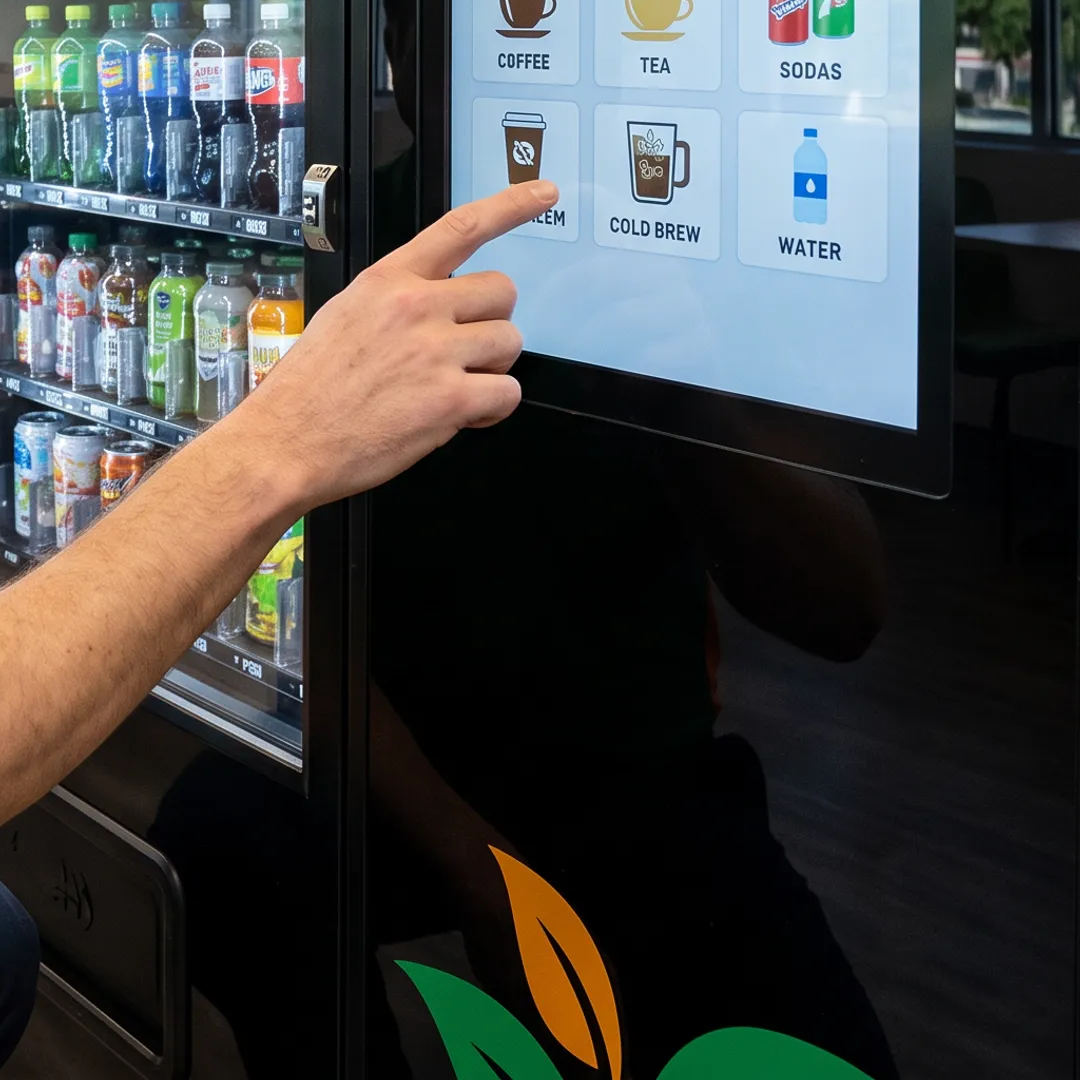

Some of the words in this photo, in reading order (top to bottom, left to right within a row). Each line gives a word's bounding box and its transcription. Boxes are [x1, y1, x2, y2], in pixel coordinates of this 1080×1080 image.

[497, 52, 550, 70] COFFEE
[639, 56, 671, 75] TEA
[779, 61, 843, 81] SODAS
[609, 216, 651, 237] COLD
[654, 221, 702, 244] BREW
[777, 236, 842, 262] WATER
